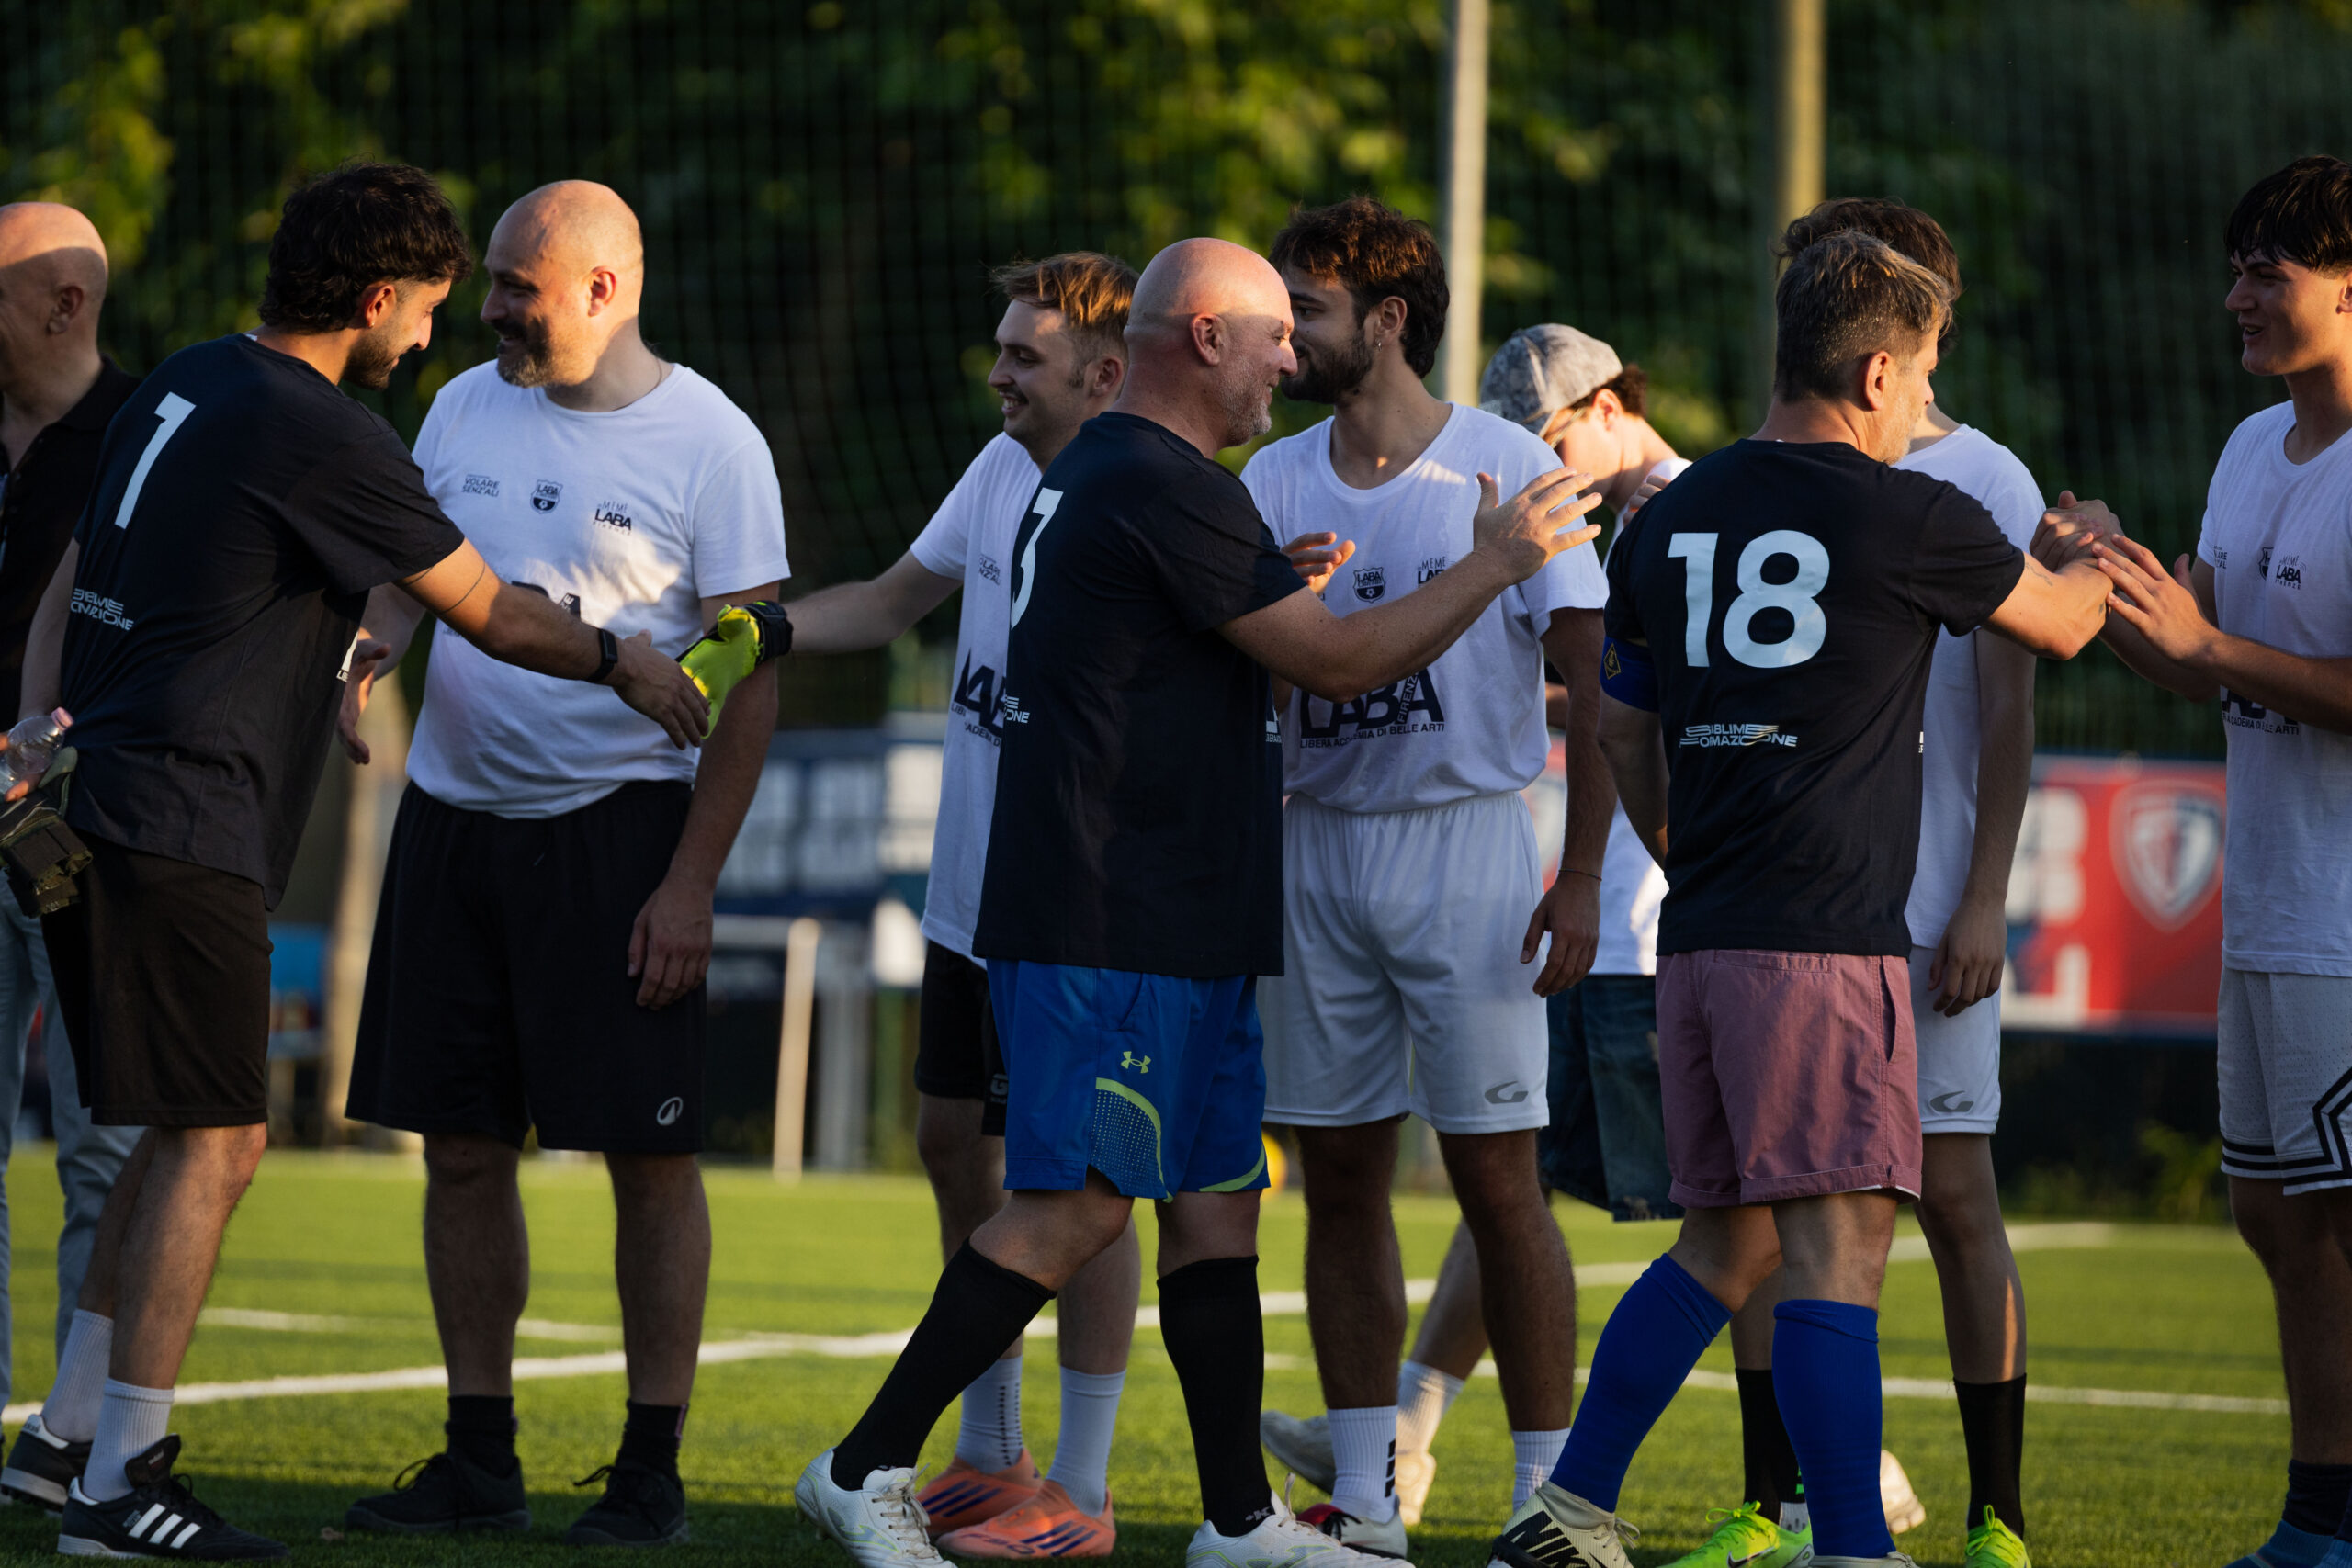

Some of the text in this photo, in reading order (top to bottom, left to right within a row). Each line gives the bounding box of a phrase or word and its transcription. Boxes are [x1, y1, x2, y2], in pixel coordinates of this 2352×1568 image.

[115, 391, 197, 529] 1
[465, 477, 500, 489] VOLARE
[537, 483, 559, 496] LABA
[594, 508, 632, 531] LABA
[1357, 571, 1382, 582] LABA
[2276, 563, 2301, 585] LABA
[1668, 529, 1830, 669] 18
[1397, 671, 1419, 724] FIRENZ
[1300, 739, 1332, 749] LIBERA
[1377, 728, 1387, 737] DI
[1389, 724, 1419, 735] BELLE
[1422, 724, 1445, 733] ARTI
[2275, 725, 2300, 736] ARTI
